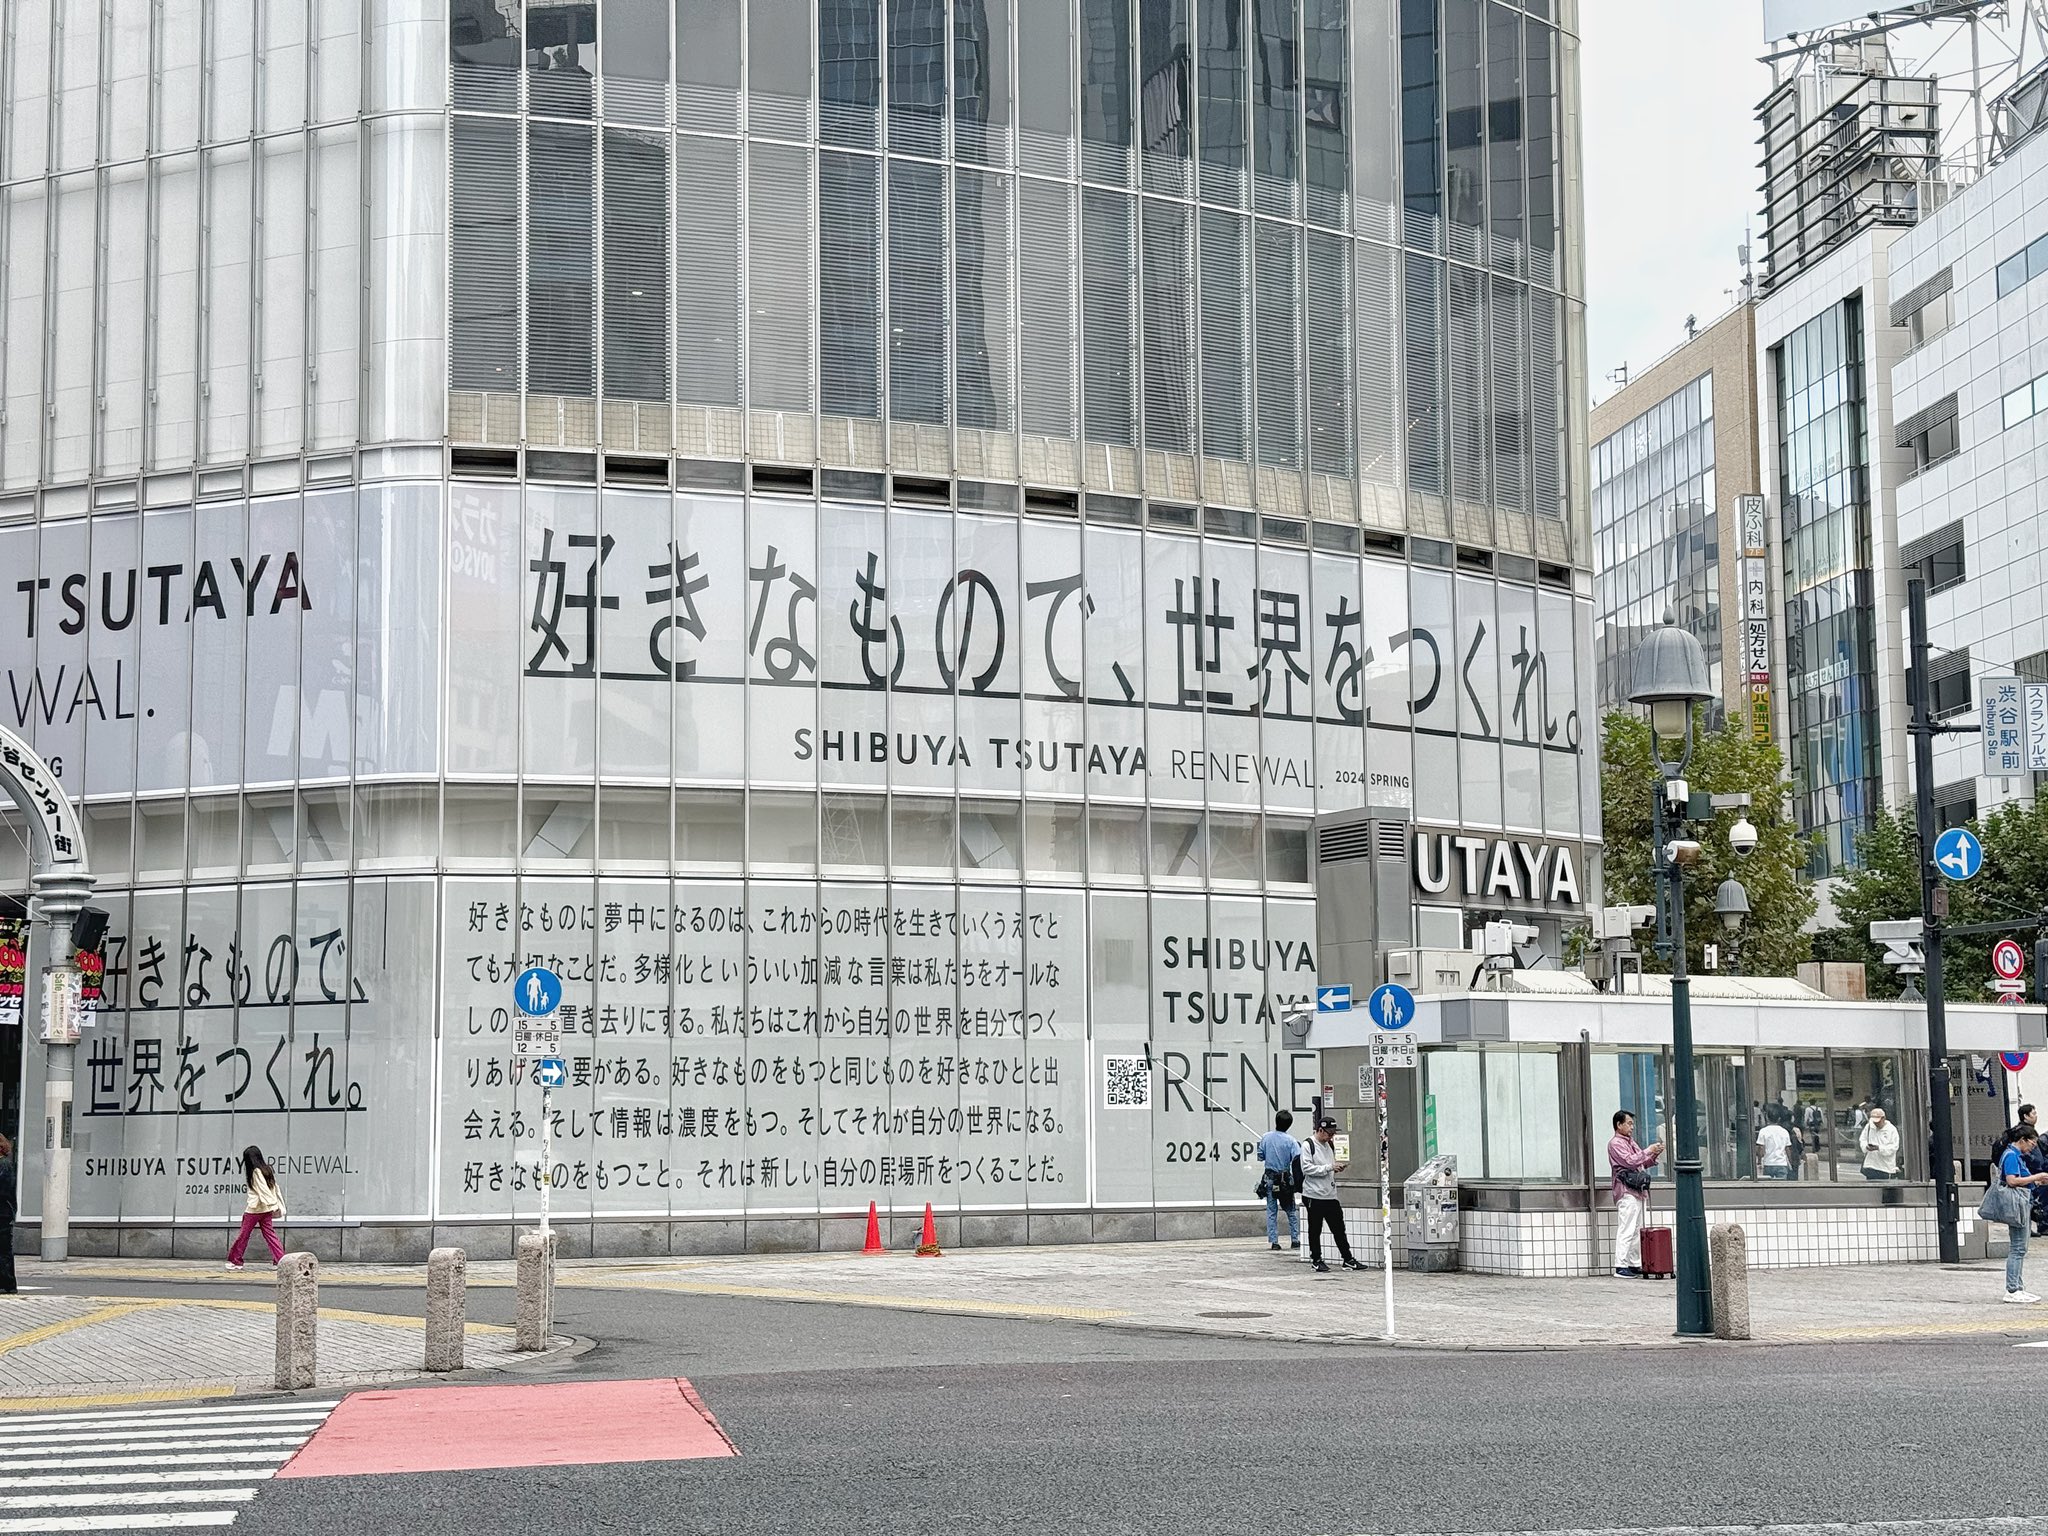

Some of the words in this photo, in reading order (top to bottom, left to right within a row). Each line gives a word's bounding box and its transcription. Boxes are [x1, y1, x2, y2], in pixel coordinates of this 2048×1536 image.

[1746, 498, 1763, 546] 皮ふ科
[17, 551, 313, 639] TSUTAYA
[1749, 580, 1765, 615] 内科
[523, 527, 1583, 753] 好きなもので、世界をつくれ。
[1749, 623, 1767, 670] 処方せん
[1986, 698, 1996, 737] Shibuya
[1998, 685, 2020, 769] 渋谷駅前
[2029, 687, 2046, 767] スクランブル式
[794, 728, 971, 767] SHIBUYA
[989, 737, 1150, 777] TSUTAYA
[1171, 750, 1324, 790] RENEWAL.
[1335, 770, 1365, 785] 2024
[1370, 773, 1410, 789] SPRING
[1988, 740, 1998, 759] Sta.
[0, 738, 72, 855] 谷センター街
[1415, 832, 1581, 904] UTAYA
[1163, 936, 1317, 972] SHIBUYA
[467, 1003, 1059, 1039] しの置き去りにする。私たちはこれから自分の世界を自分でつく
[518, 1021, 528, 1030] 15
[550, 1021, 557, 1031] 5
[1163, 991, 1312, 1026] TSUTA
[517, 1043, 527, 1053] 12
[549, 1043, 556, 1053] 5
[1374, 1035, 1384, 1044] 15
[1405, 1035, 1412, 1044] 5
[86, 1032, 364, 1116] 世界をつくれ。
[466, 1055, 1059, 1088] りあげる要がある。好きなものをもつと同じものを好きなひとと出
[1375, 1057, 1385, 1066] 12
[1406, 1057, 1413, 1066] 5
[1163, 1051, 1317, 1113] RENE
[85, 1158, 166, 1176] SHIBUYA
[176, 1158, 247, 1176] TSUTAY
[1166, 1141, 1221, 1163] 2024
[185, 1184, 209, 1195] 2024
[213, 1183, 247, 1195] SPRING
